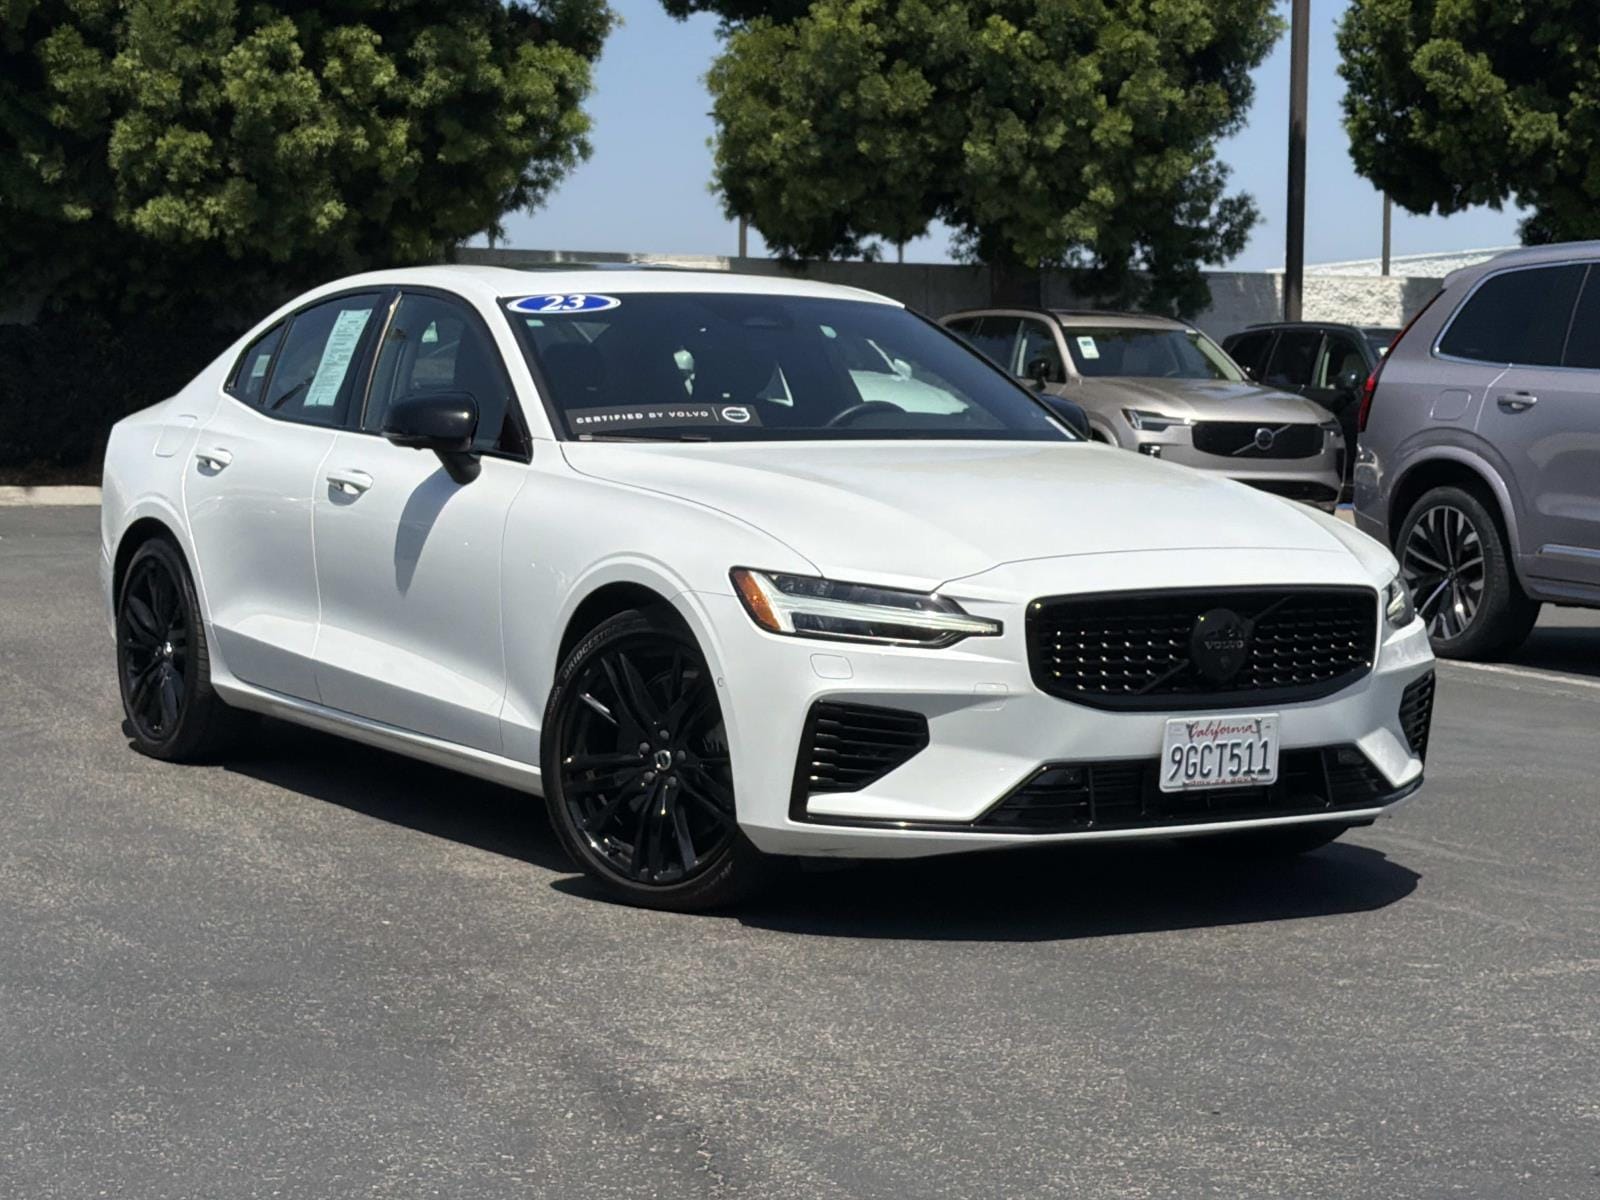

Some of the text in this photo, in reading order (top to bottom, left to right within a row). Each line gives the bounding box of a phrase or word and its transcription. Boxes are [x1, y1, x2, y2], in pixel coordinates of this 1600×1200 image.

[540, 293, 588, 311] 23
[576, 410, 709, 424] CERTIFIED BY VOLVO
[1204, 639, 1244, 650] VOLVO
[1190, 720, 1259, 741] California
[1169, 740, 1271, 781] 9GCT511
